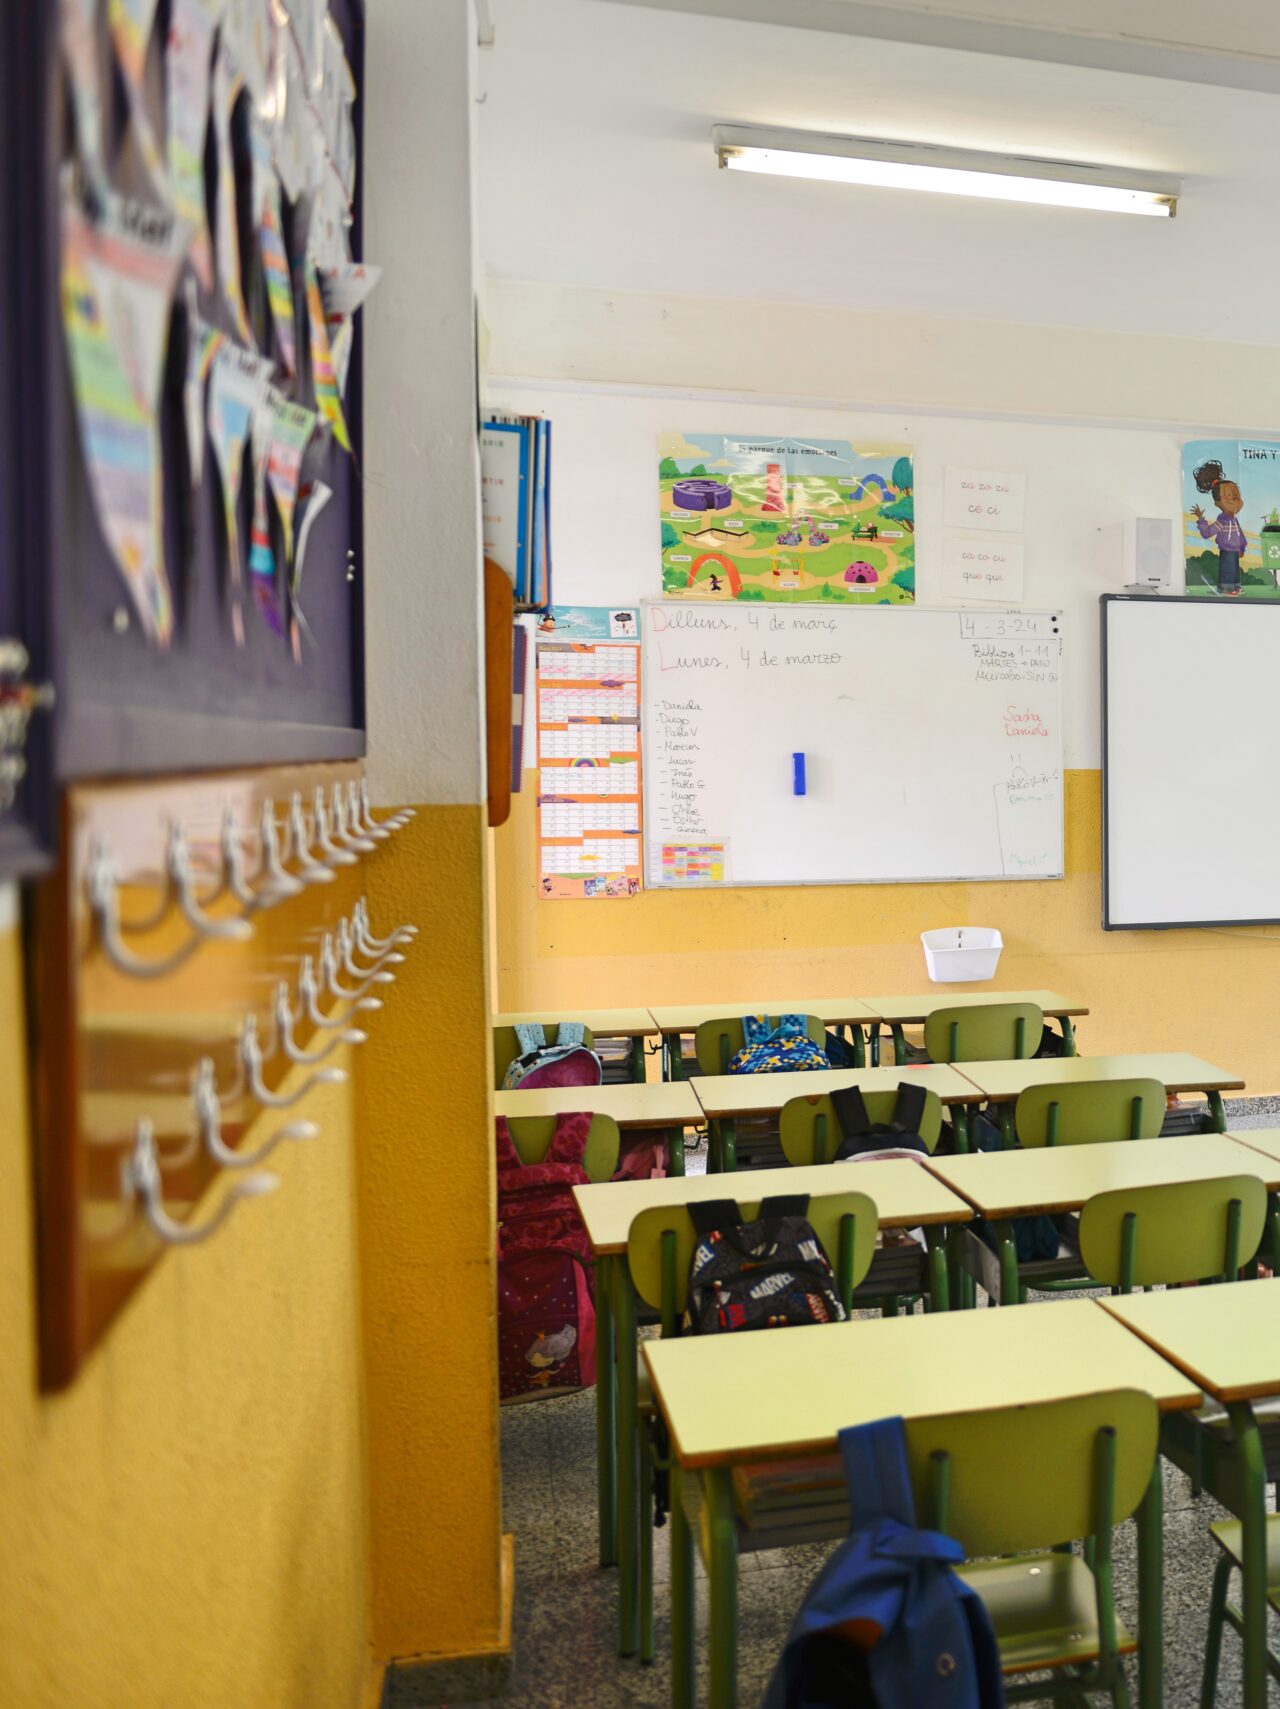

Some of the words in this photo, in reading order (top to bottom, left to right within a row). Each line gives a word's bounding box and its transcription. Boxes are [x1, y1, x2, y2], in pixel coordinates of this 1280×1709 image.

[1243, 449, 1267, 459] TINA
[1270, 450, 1276, 460] Y
[968, 504, 983, 514] ce
[748, 608, 759, 631] 4
[769, 613, 785, 632] de
[792, 618, 839, 634] març
[740, 646, 750, 670] 4
[759, 650, 780, 667] de
[785, 652, 843, 665] marzo
[690, 727, 698, 736] V
[749, 1272, 796, 1300] MARVEL
